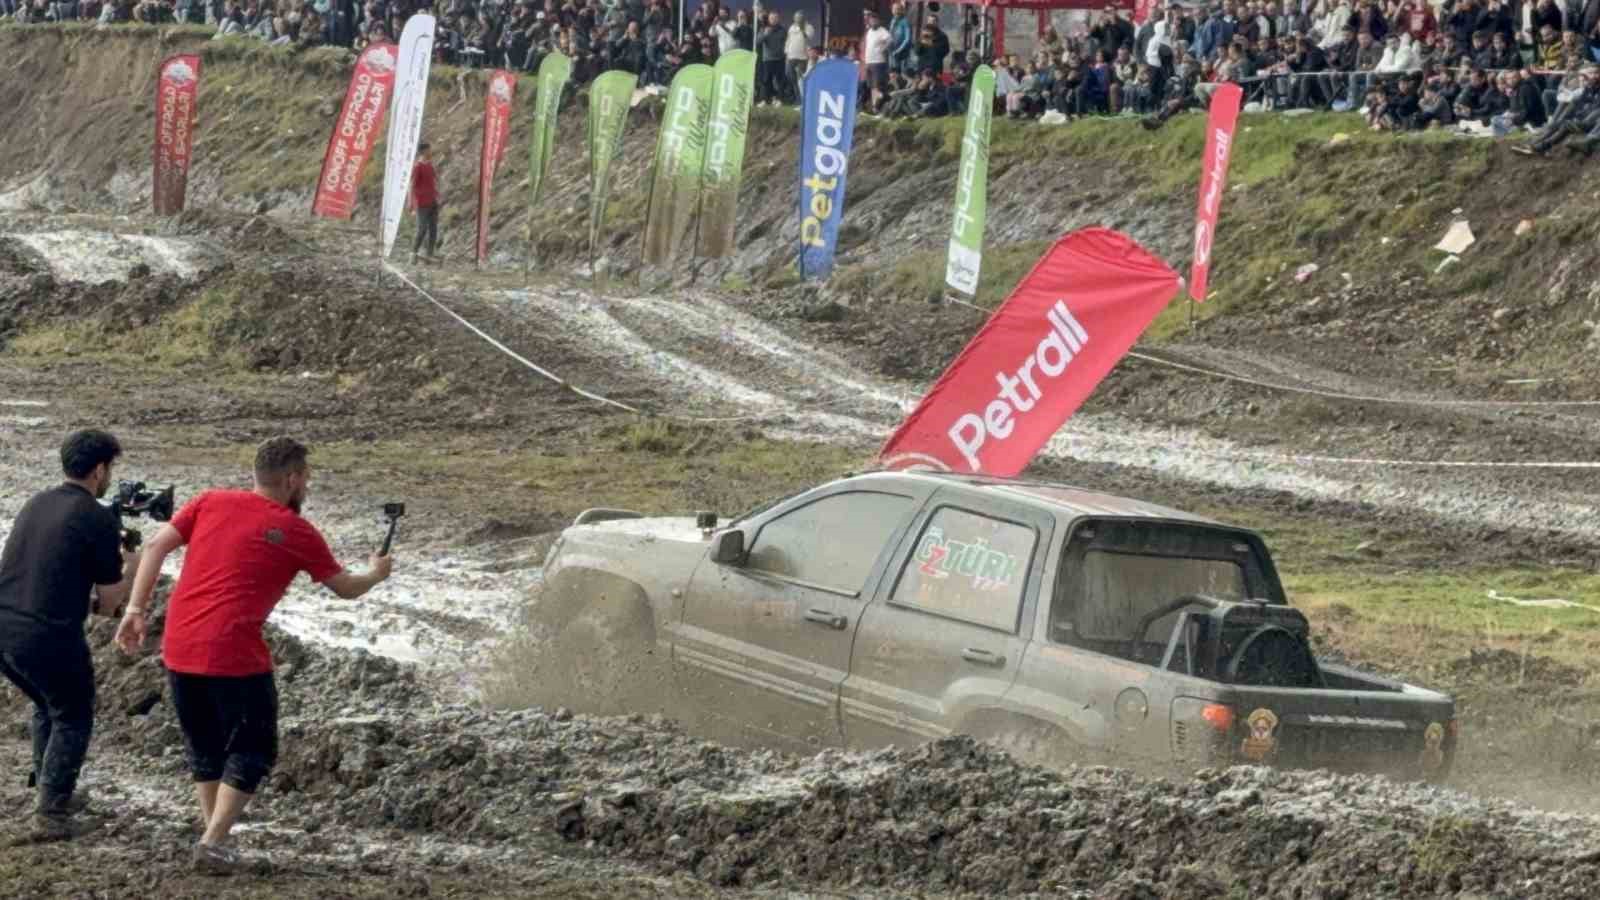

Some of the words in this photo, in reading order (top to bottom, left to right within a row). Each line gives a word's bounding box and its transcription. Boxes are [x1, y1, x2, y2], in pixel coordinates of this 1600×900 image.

[161, 86, 177, 145] OFFROAD
[341, 74, 370, 136] OFFROAD
[353, 81, 385, 151] SPORLARI
[802, 90, 846, 247] Petgaz
[947, 299, 1089, 472] Petrall
